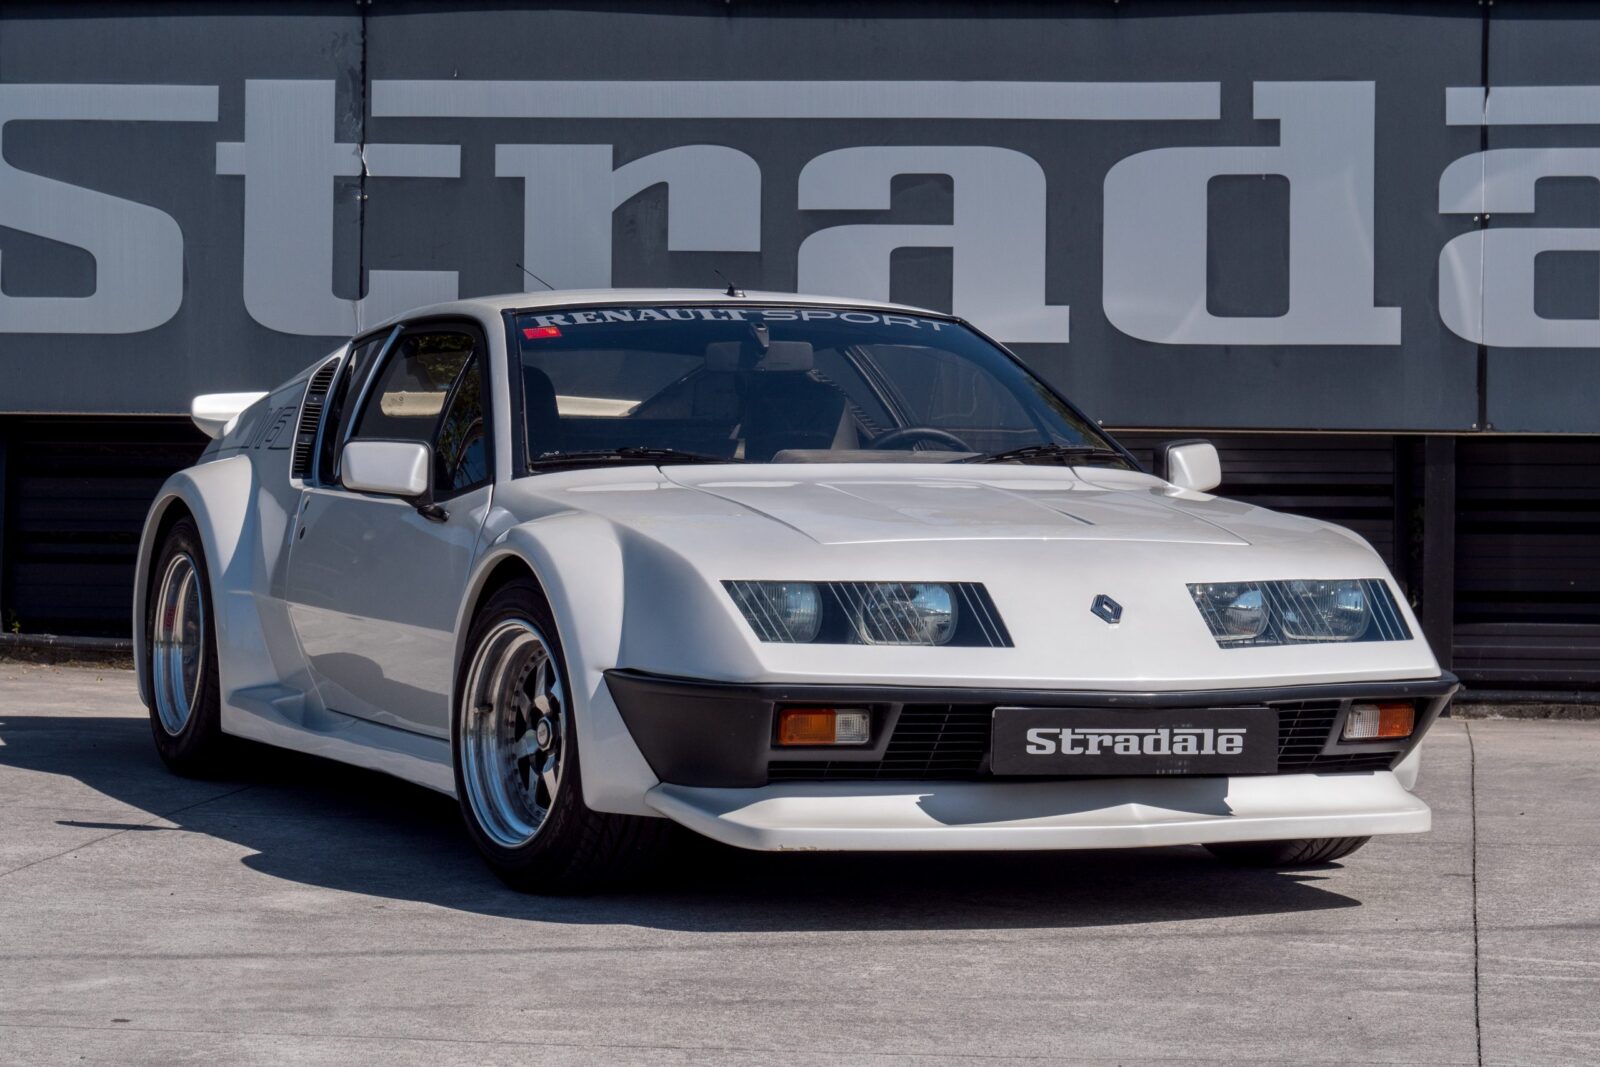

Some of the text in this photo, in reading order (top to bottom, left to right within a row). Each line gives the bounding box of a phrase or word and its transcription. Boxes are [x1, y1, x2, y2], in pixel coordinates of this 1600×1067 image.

[531, 308, 950, 331] RENAULT SPORT
[1026, 728, 1247, 755] Stradale
